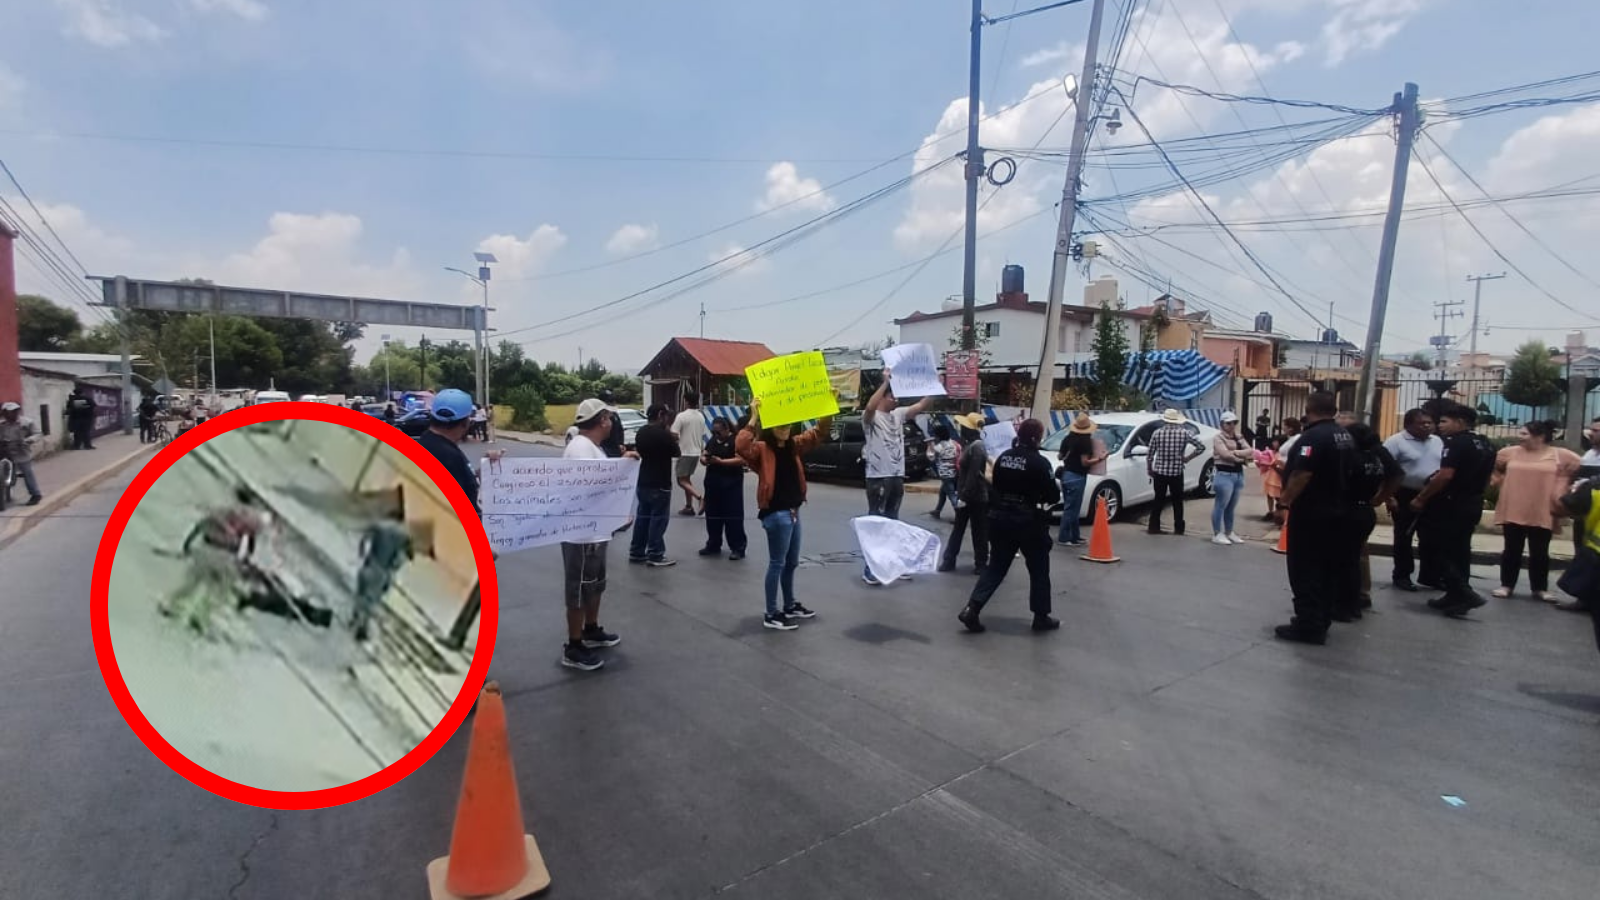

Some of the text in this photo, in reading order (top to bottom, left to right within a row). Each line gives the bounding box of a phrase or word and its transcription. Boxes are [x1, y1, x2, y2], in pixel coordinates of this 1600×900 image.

[512, 462, 553, 475] acuerdo
[556, 467, 573, 476] que
[516, 494, 562, 505] animales
